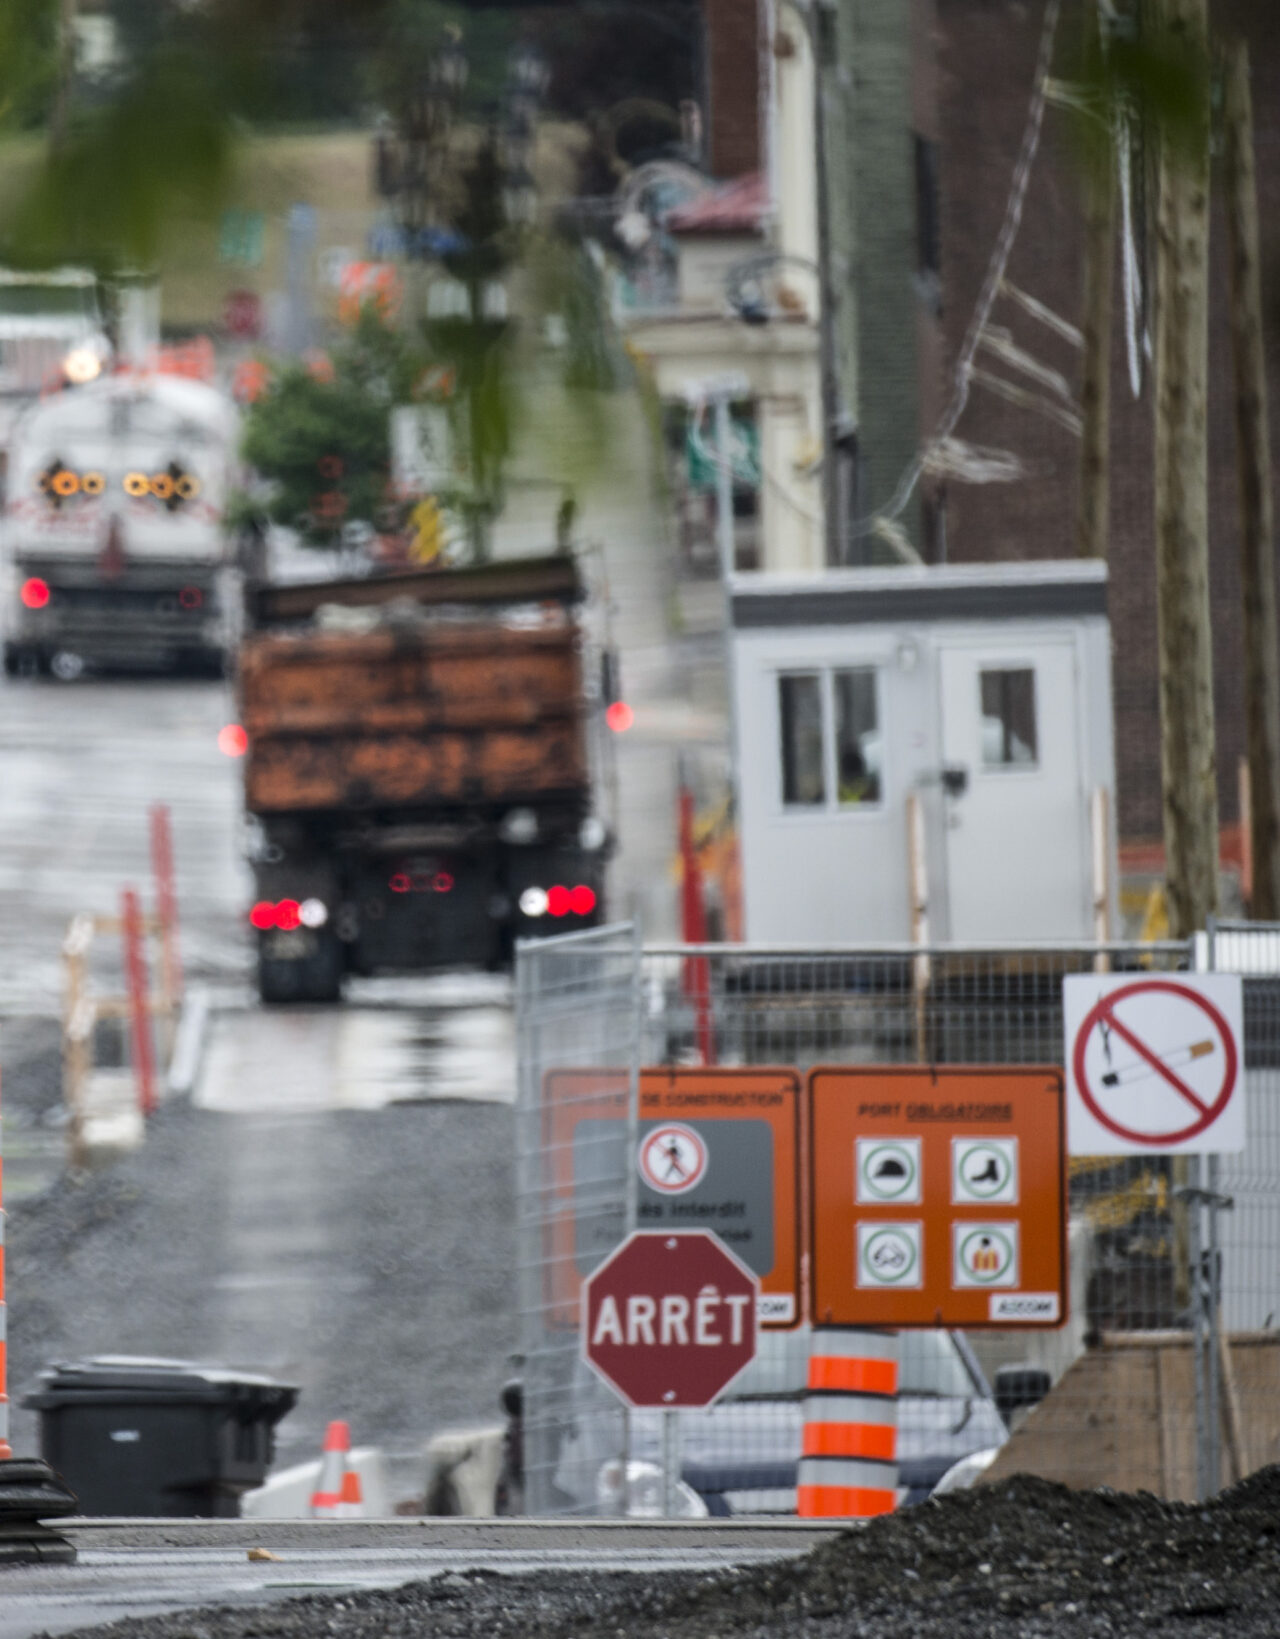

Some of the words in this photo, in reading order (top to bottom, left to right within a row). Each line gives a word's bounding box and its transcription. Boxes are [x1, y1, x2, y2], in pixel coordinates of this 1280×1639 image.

[664, 1093, 784, 1106] CONSTRUCTION
[858, 1103, 901, 1117] PORT
[906, 1103, 1012, 1120] OBLIGATOIRE
[592, 1285, 751, 1346] ARRÊT
